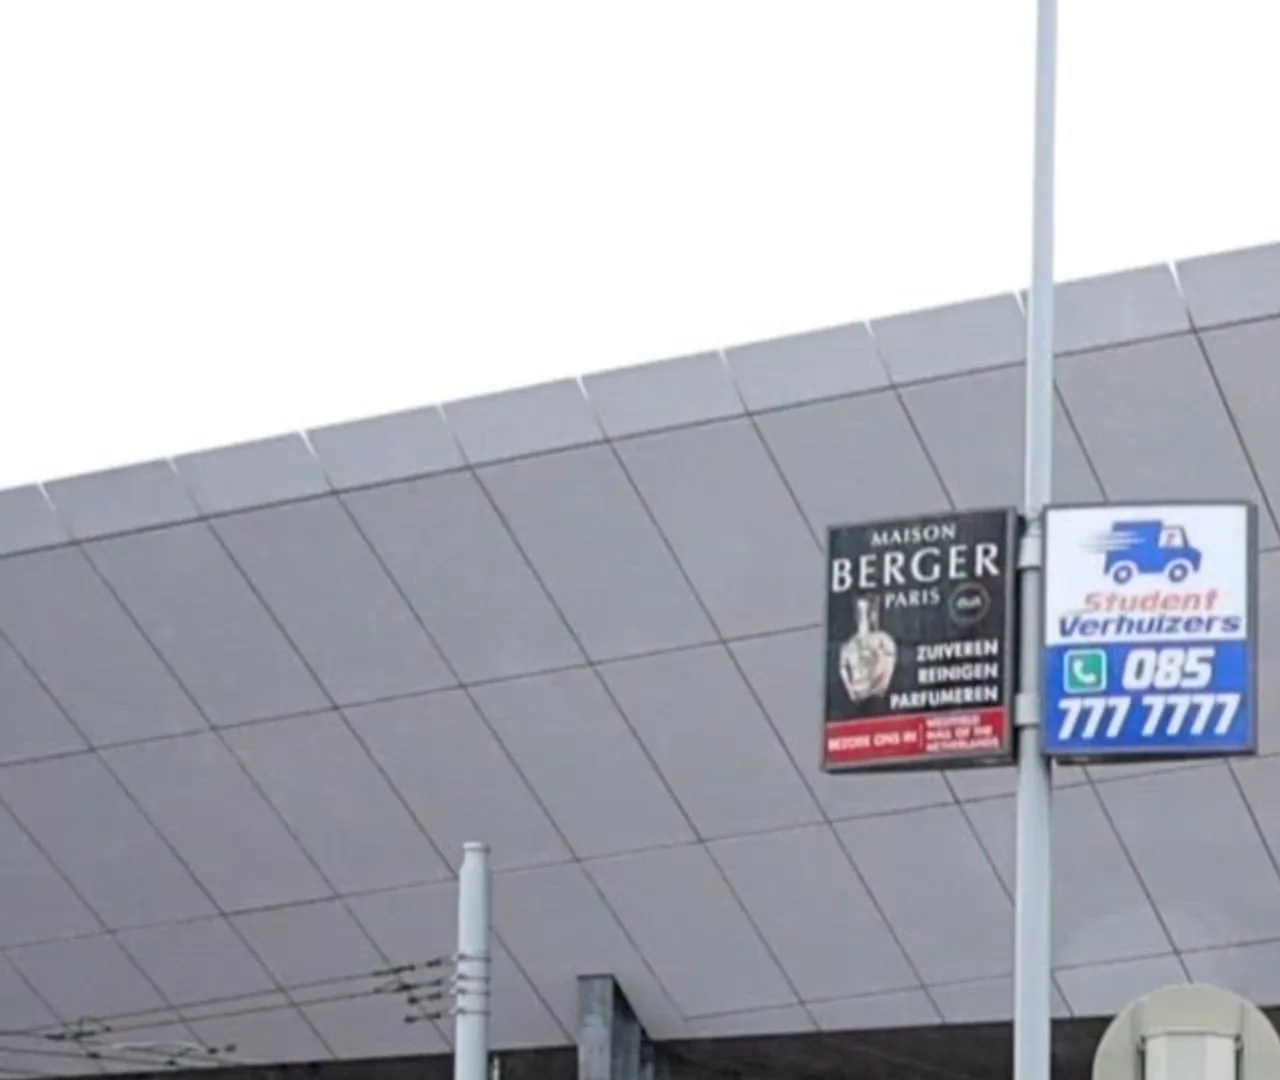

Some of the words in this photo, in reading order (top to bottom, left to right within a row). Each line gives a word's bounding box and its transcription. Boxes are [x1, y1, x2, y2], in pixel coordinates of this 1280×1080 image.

[870, 523, 956, 547] MAISON
[832, 542, 999, 593] BERGER
[884, 588, 940, 609] PARIS
[1084, 588, 1218, 612] Student
[1059, 613, 1241, 637] Verhuizers
[916, 639, 998, 662] ZUIVEREN
[917, 664, 998, 684] REINIGEN
[1121, 647, 1215, 690] 085
[890, 687, 998, 709] PARFUMEREN
[1057, 697, 1132, 740] 777
[1141, 693, 1241, 738] 7777
